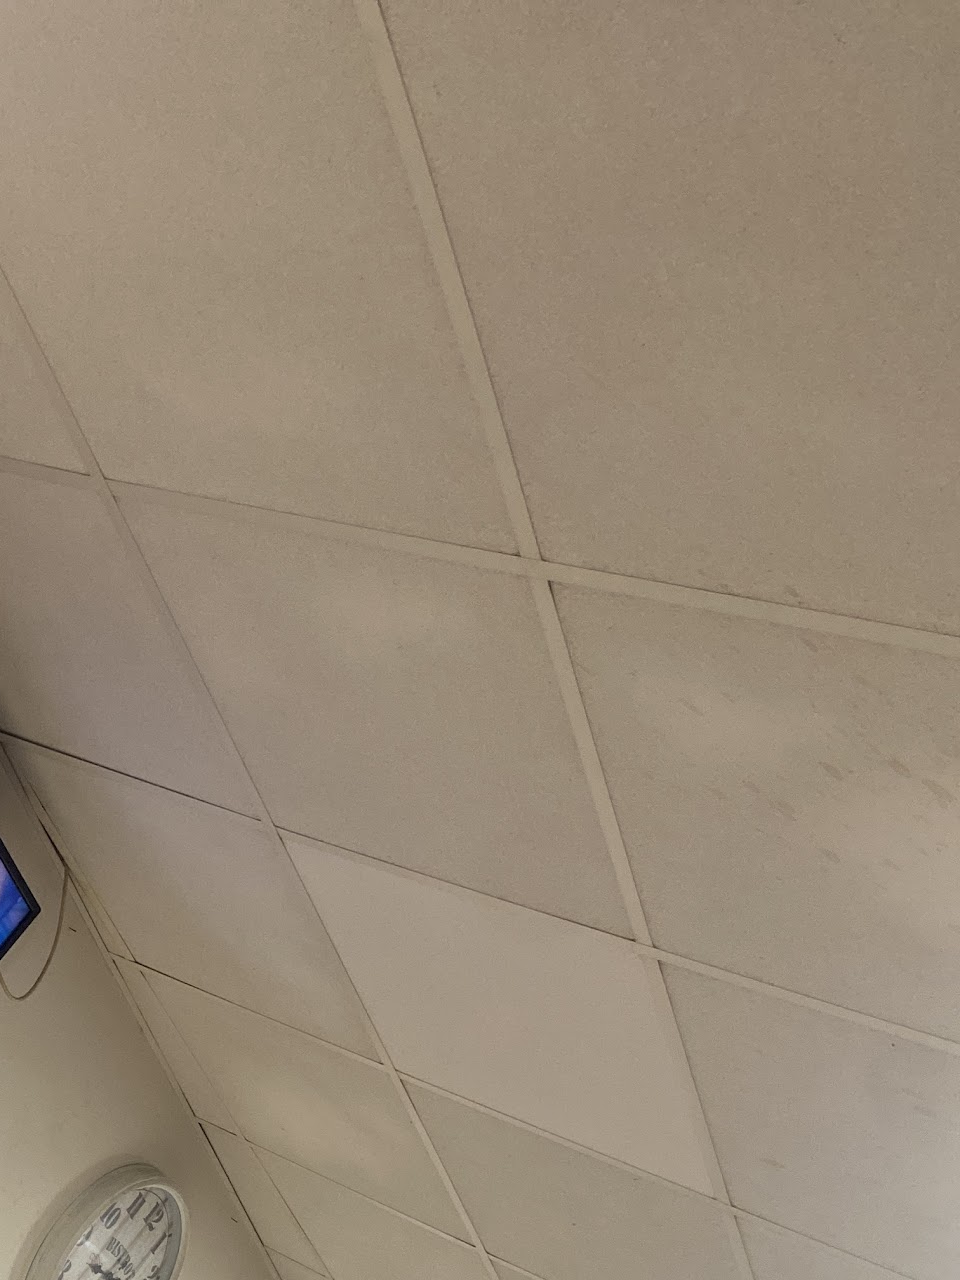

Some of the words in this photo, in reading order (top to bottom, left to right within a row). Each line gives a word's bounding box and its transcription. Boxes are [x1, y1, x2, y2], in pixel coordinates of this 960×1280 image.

[100, 1202, 122, 1230] 10
[126, 1191, 147, 1220] 11
[143, 1201, 164, 1232] 12
